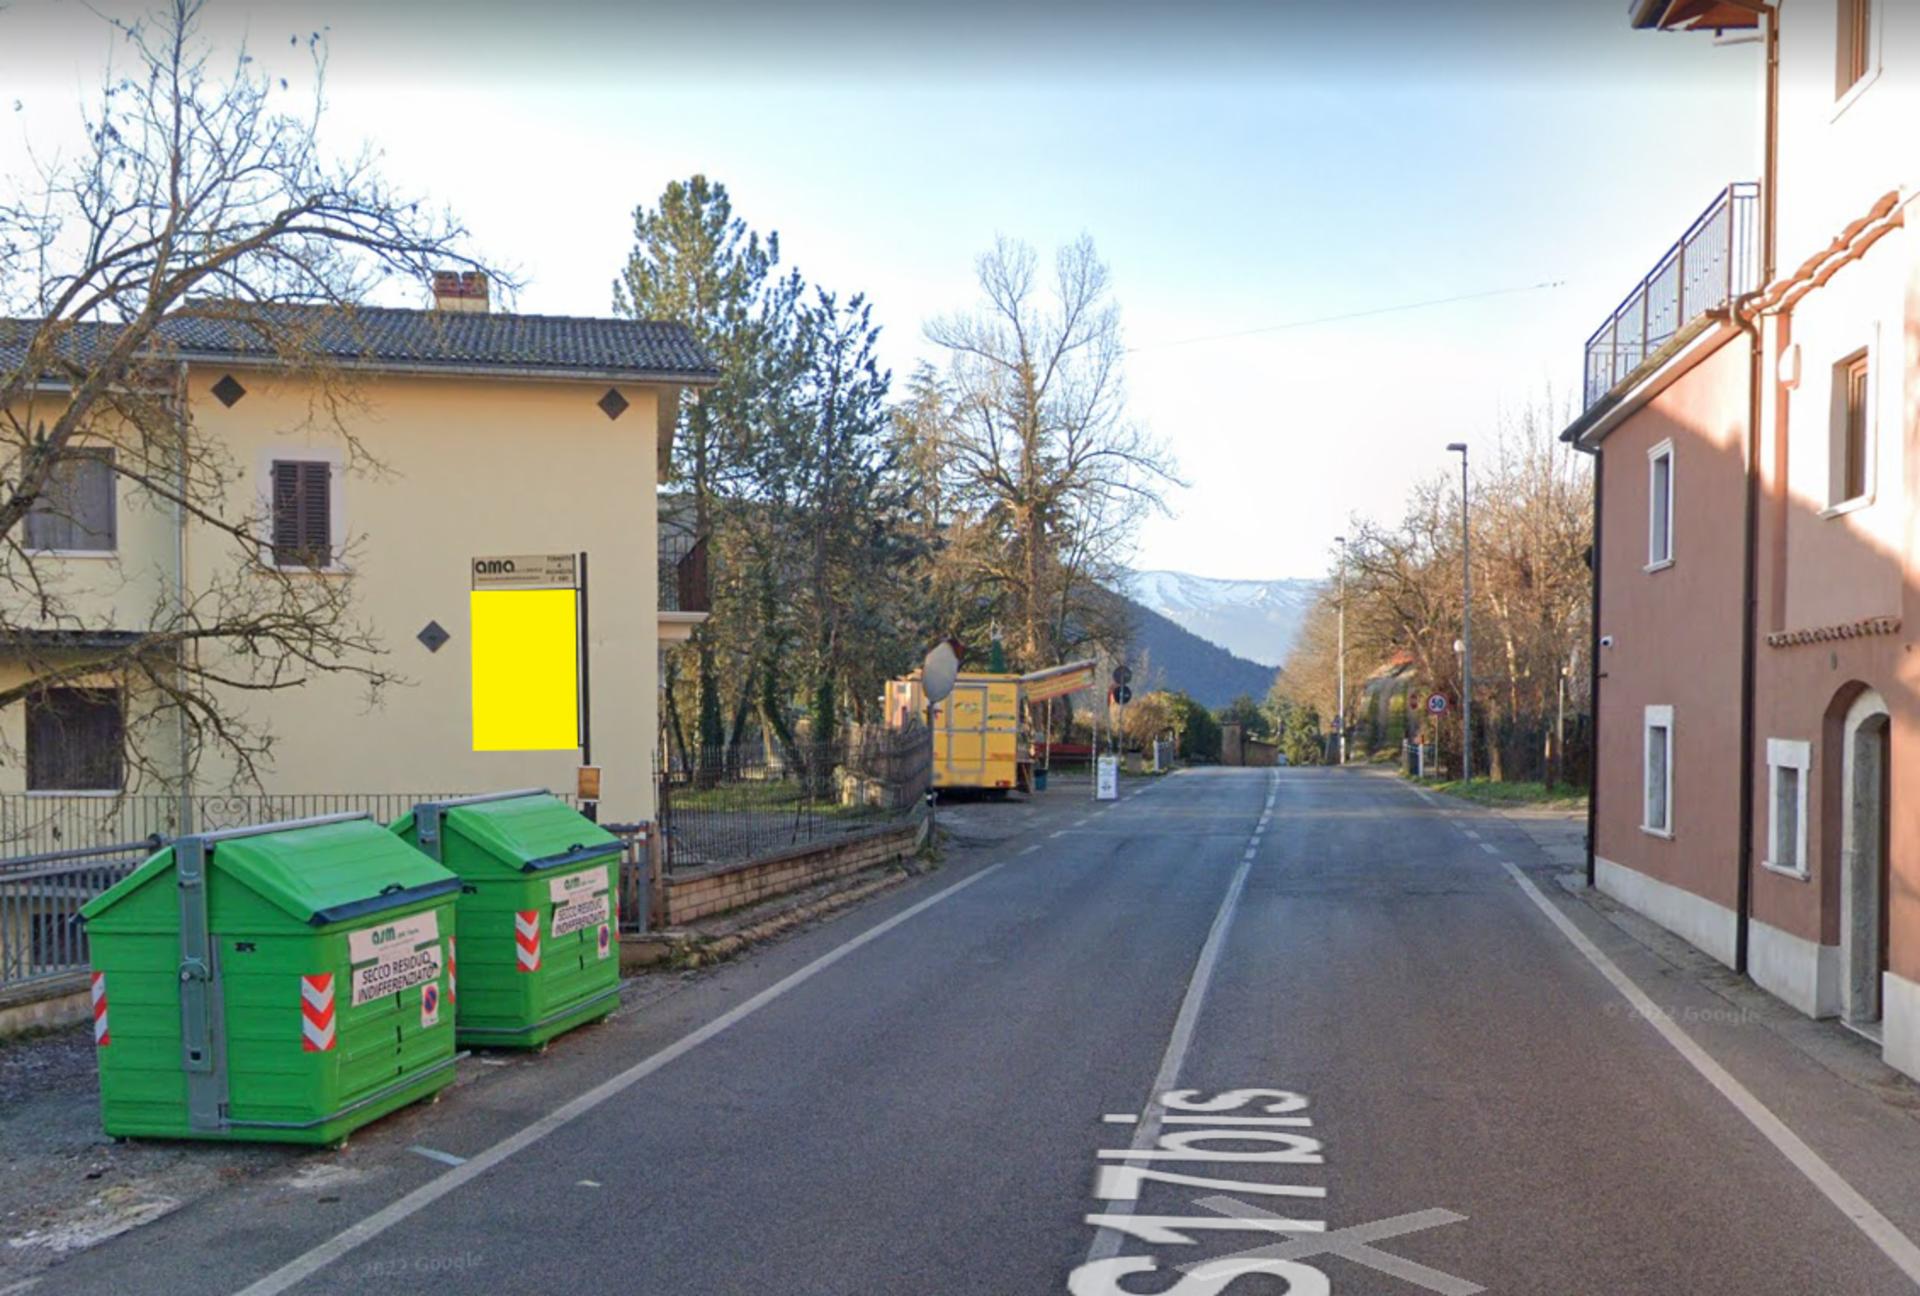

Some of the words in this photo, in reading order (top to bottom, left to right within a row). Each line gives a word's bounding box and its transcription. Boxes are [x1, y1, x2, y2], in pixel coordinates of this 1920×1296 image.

[475, 560, 515, 574] ama
[1431, 698, 1444, 709] 50
[362, 964, 391, 985] SECCO
[393, 951, 431, 974] RESIDUO
[358, 966, 434, 1003] INDIFFERENZIATO
